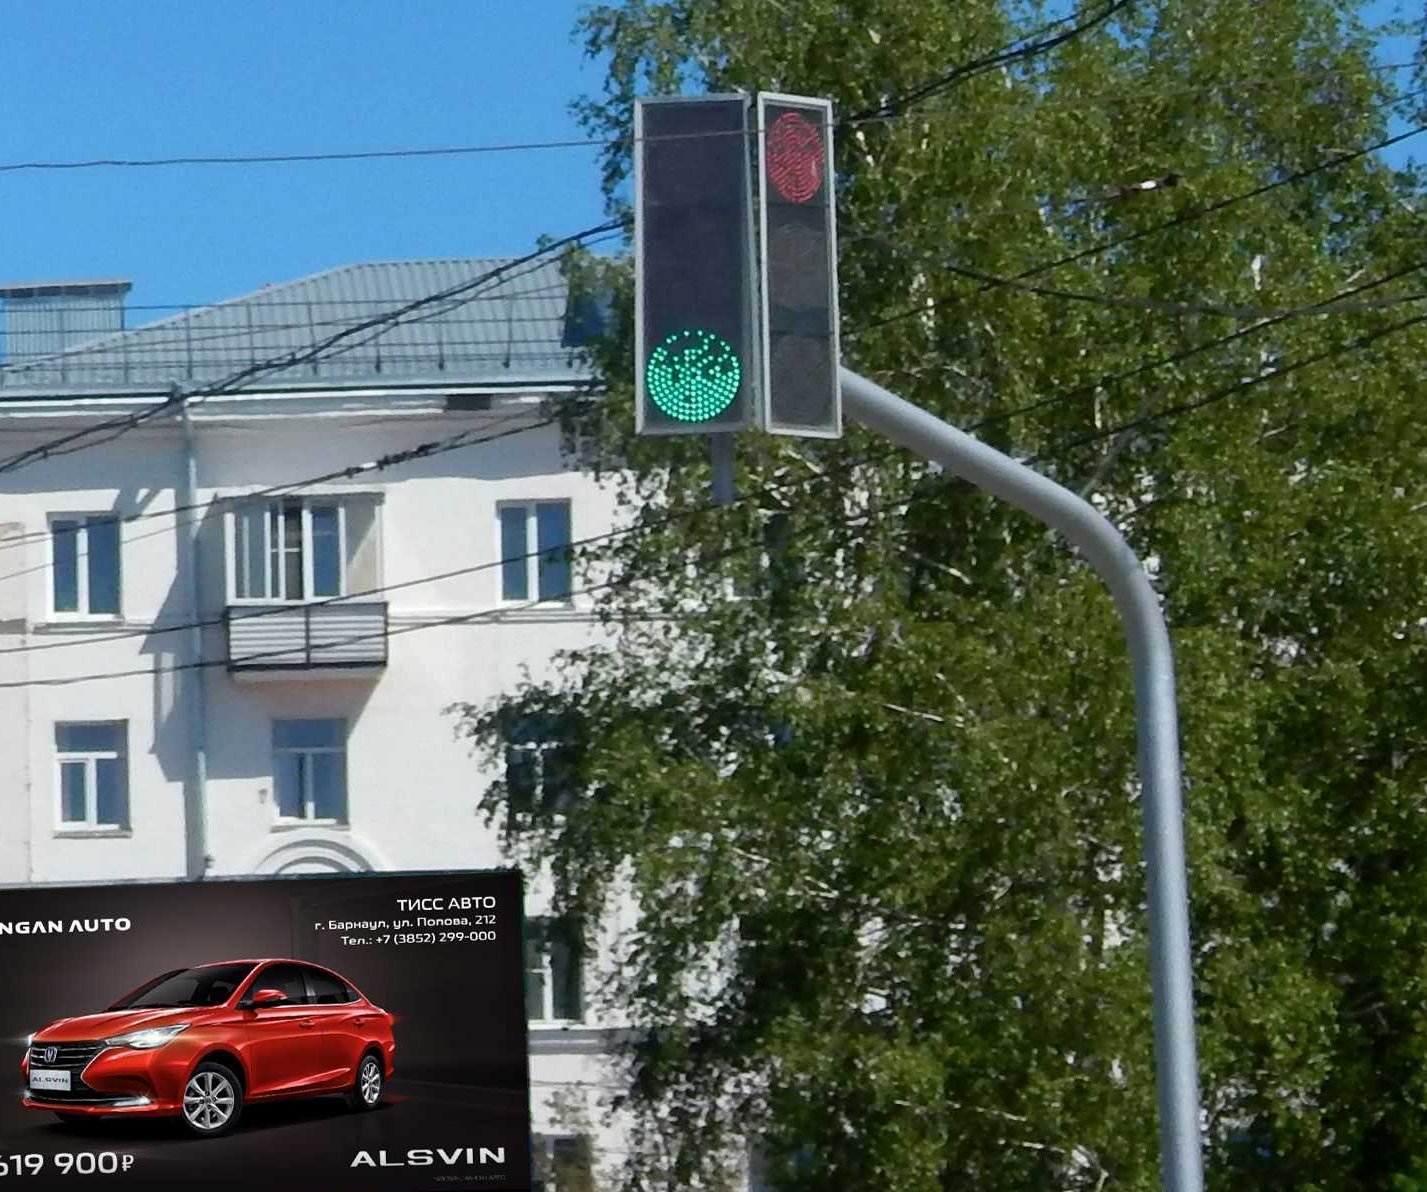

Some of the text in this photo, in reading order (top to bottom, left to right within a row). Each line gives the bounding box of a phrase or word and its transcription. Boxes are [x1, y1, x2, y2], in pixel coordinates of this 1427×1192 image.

[397, 896, 496, 911] ТИСС АВТО
[69, 917, 131, 933] AUTO
[314, 915, 496, 932] г. Барнаул, ул. Попова, 212
[341, 931, 496, 946] Тел.: +7 (3852) 299-000
[350, 1147, 506, 1168] ALSVIN
